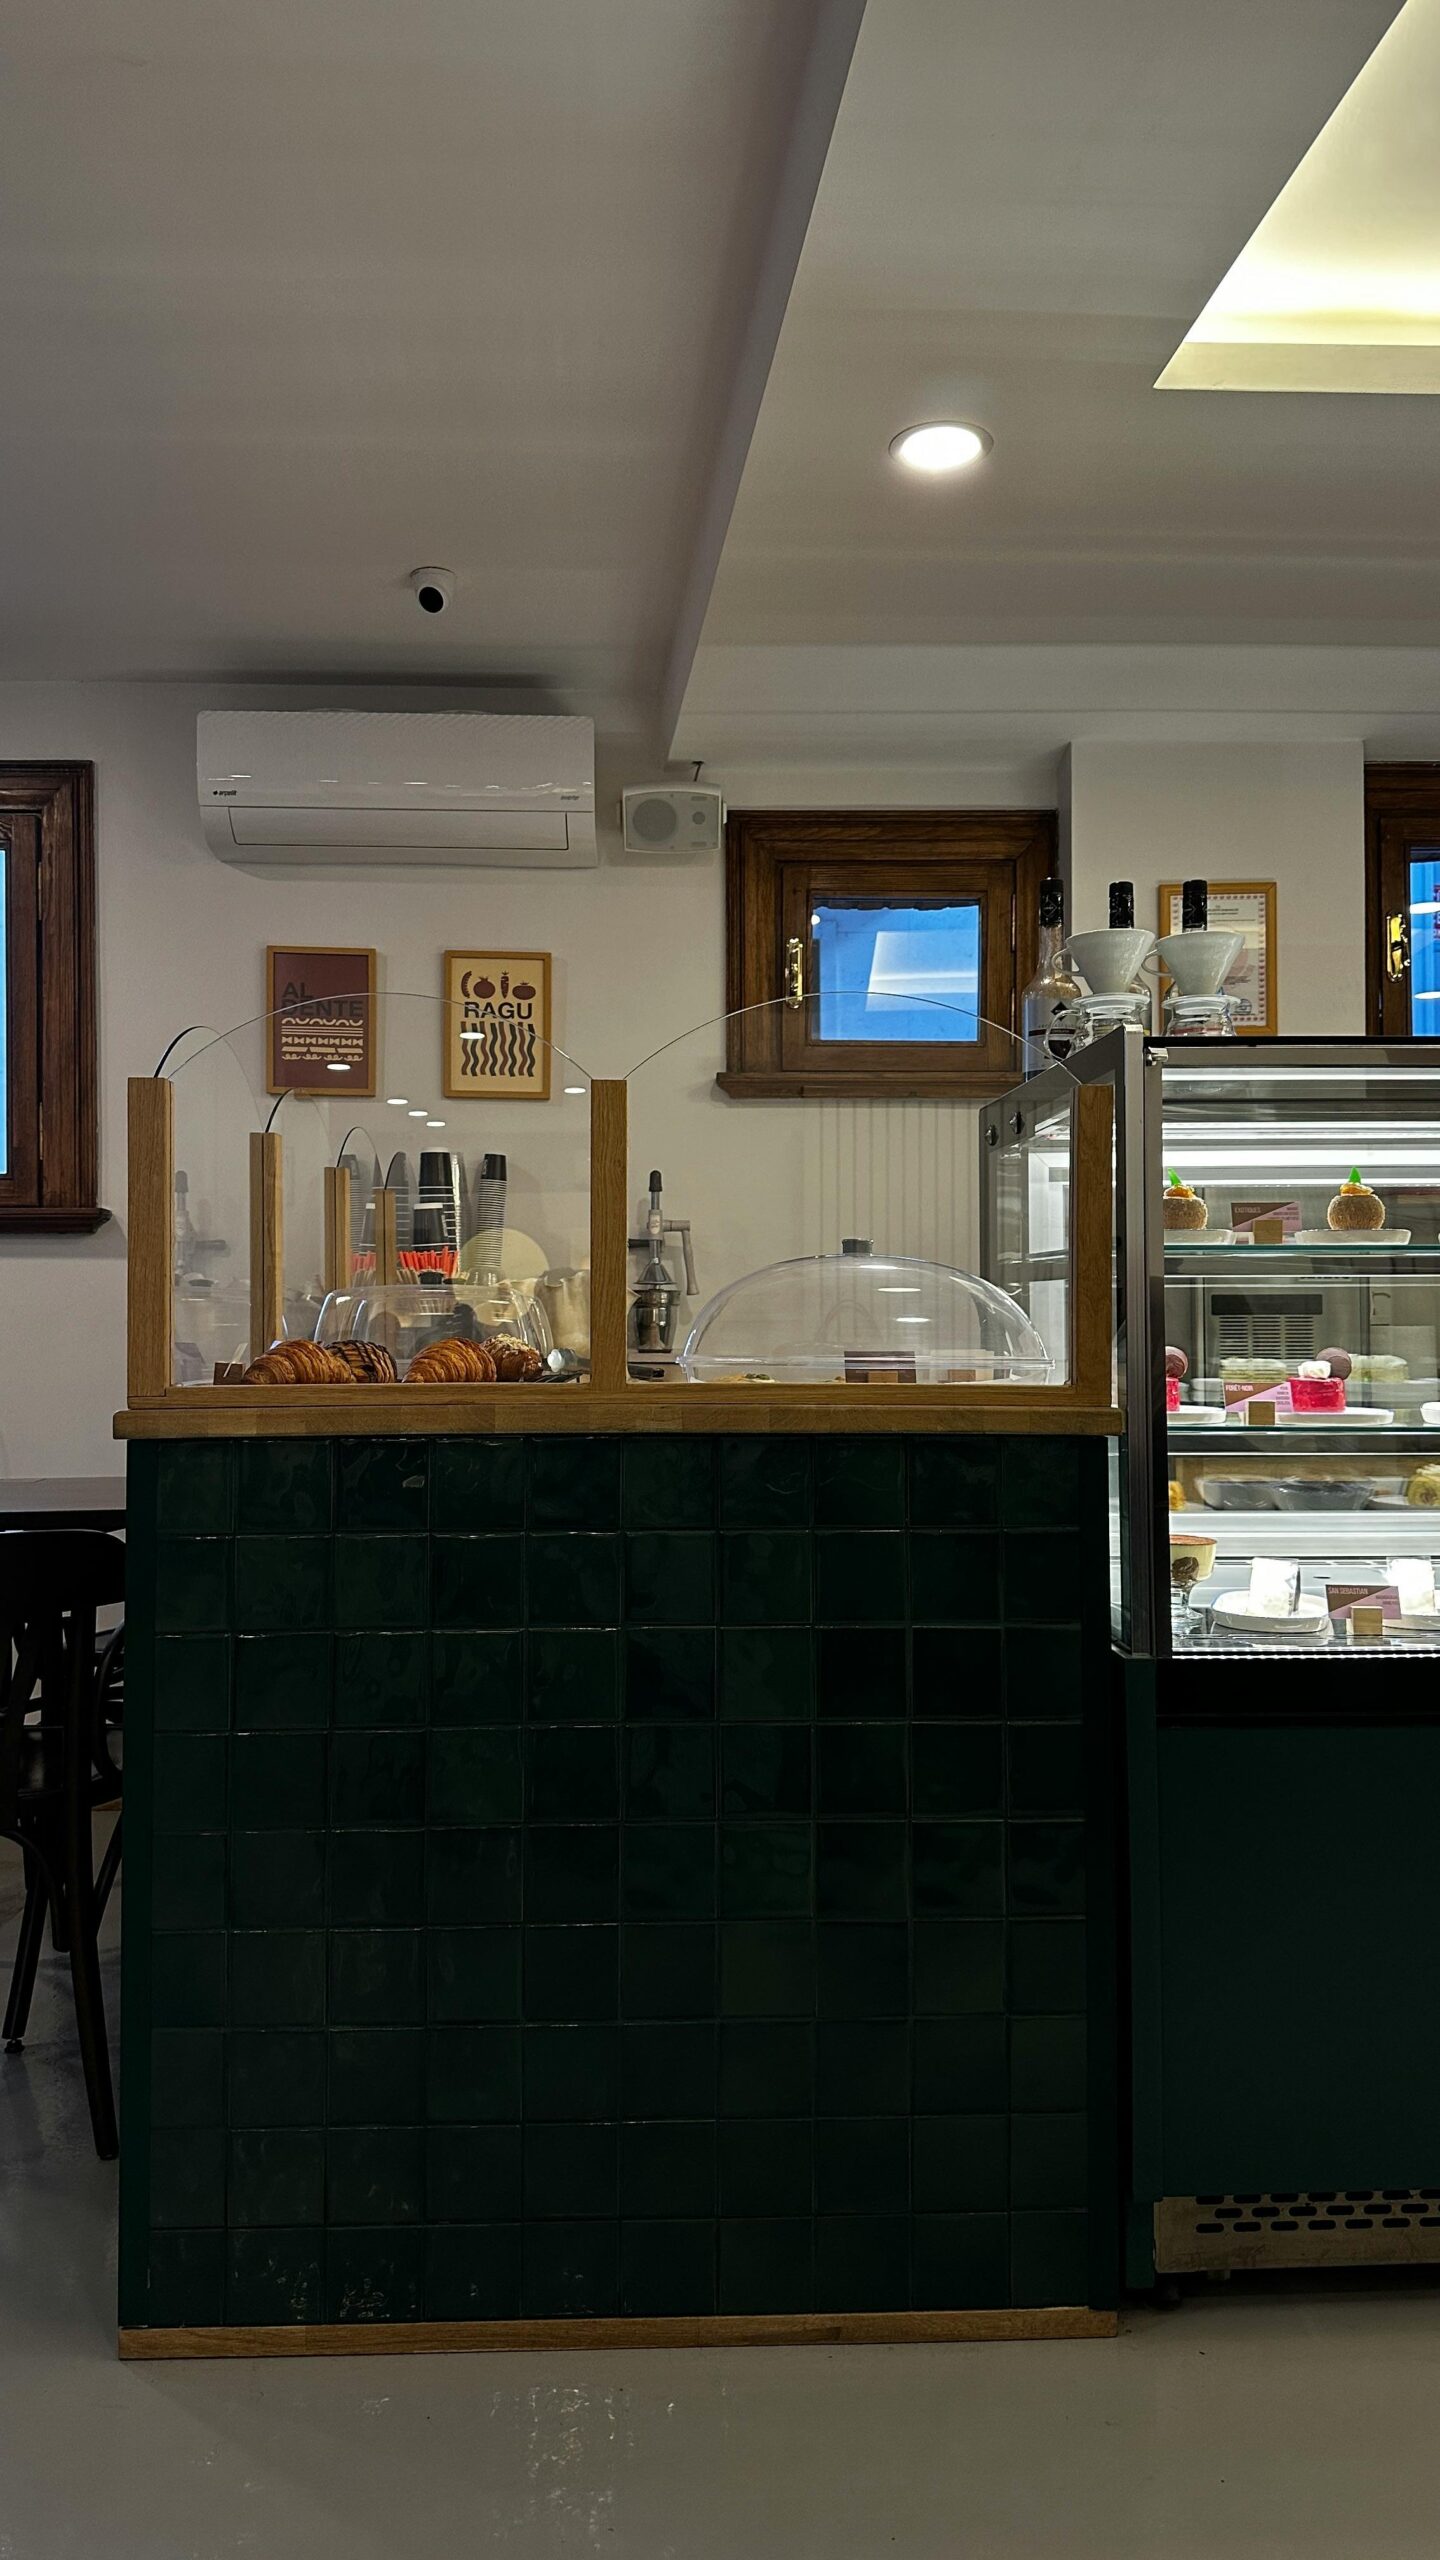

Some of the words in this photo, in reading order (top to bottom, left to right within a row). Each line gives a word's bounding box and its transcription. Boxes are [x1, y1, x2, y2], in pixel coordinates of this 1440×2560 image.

[282, 982, 313, 998] AL
[281, 999, 363, 1016] DENTE
[464, 1002, 532, 1019] RAGU
